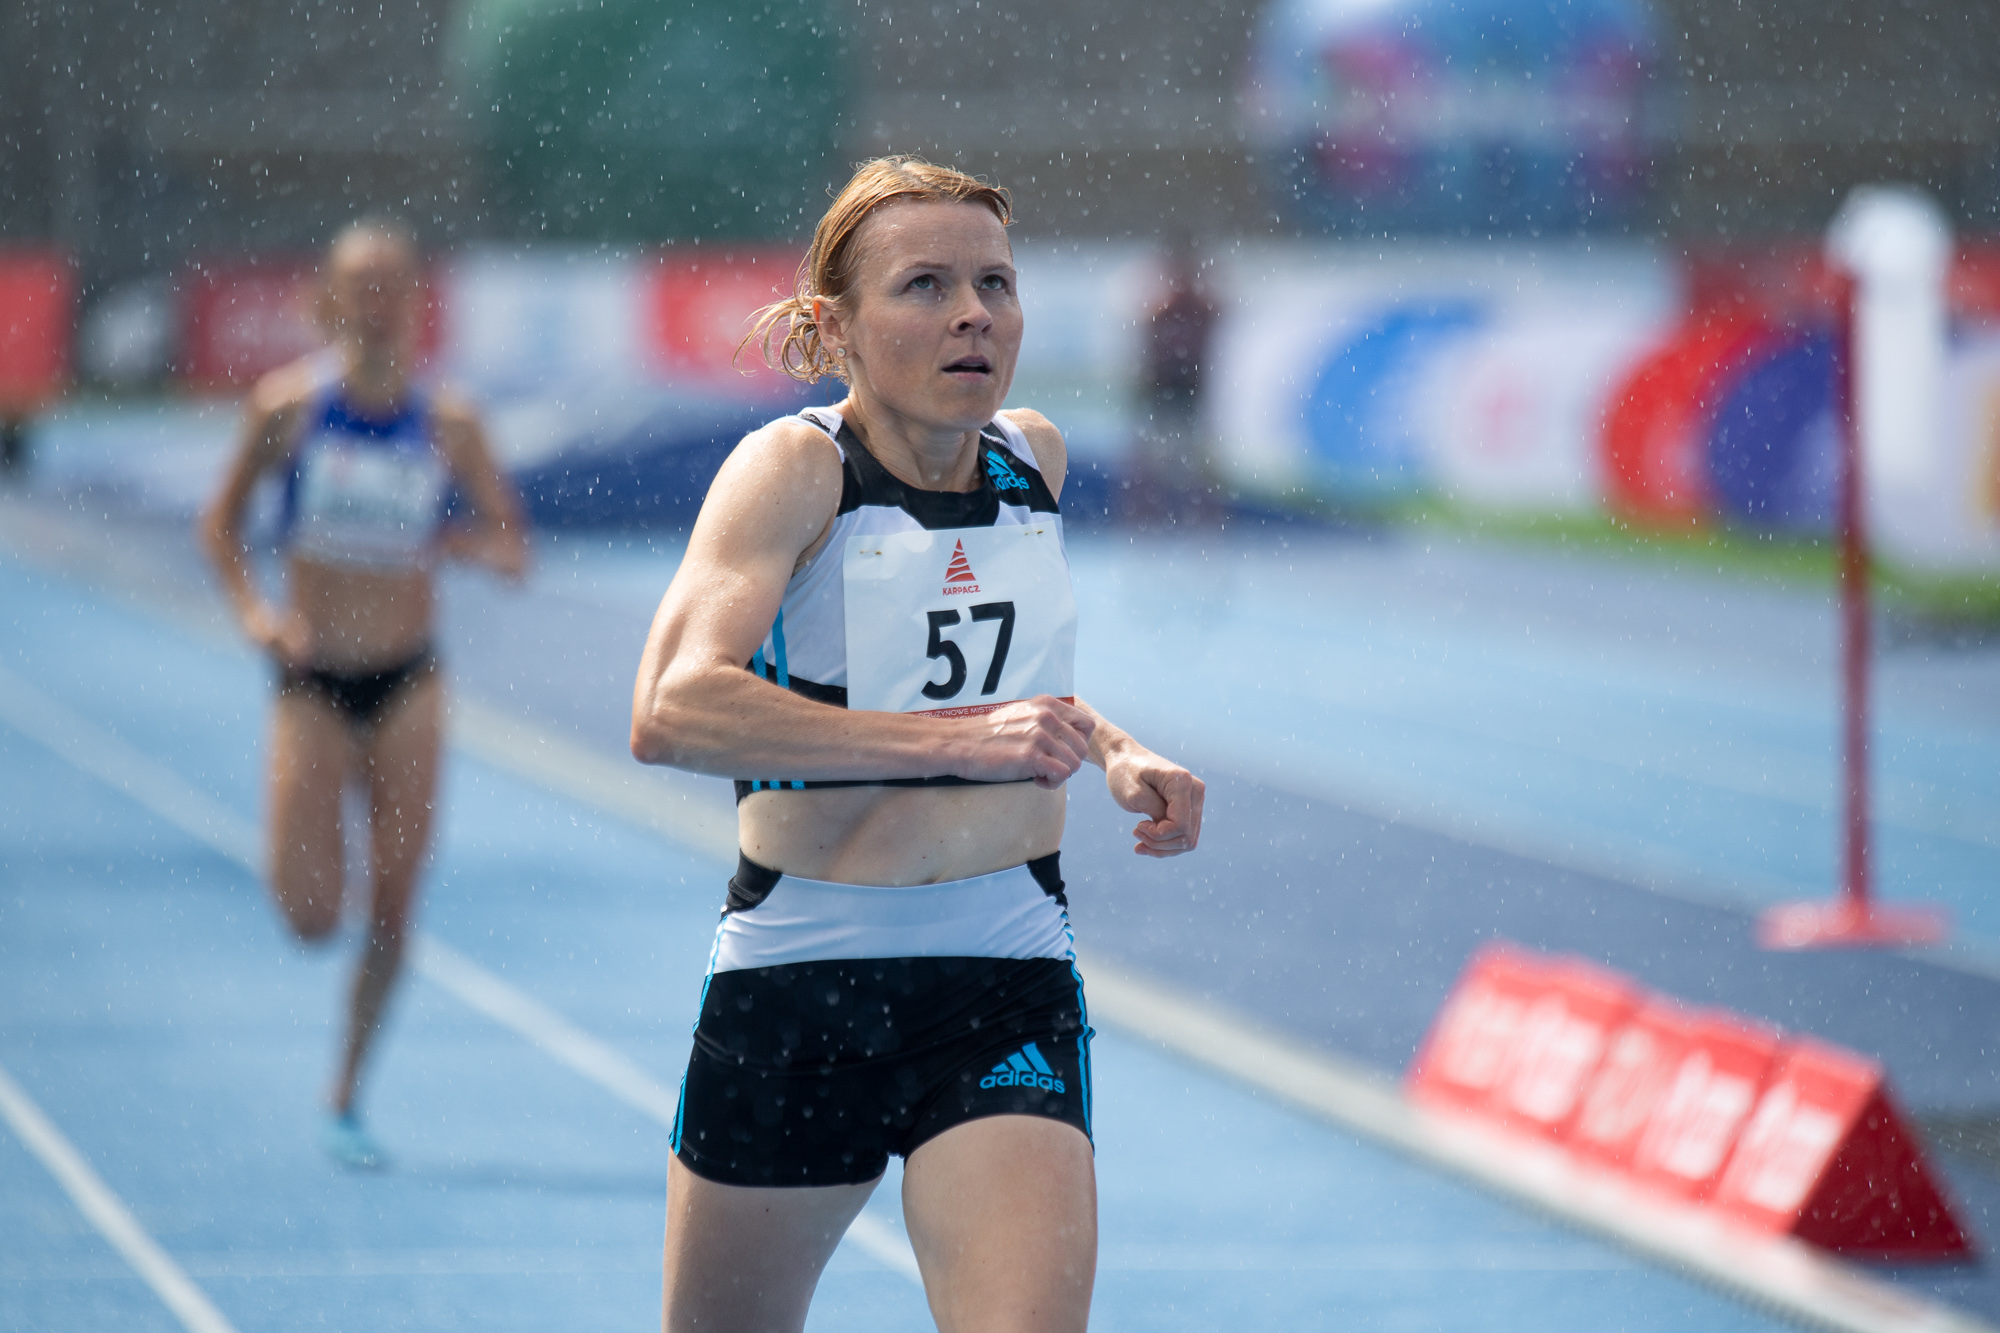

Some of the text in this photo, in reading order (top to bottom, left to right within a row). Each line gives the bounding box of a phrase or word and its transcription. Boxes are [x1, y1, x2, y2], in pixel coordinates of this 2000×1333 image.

[992, 473, 1030, 490] dids
[942, 585, 981, 596] KARPACZ
[921, 601, 1016, 700] 57
[970, 702, 1013, 714] MISTRZO
[979, 1070, 1066, 1094] adidas
